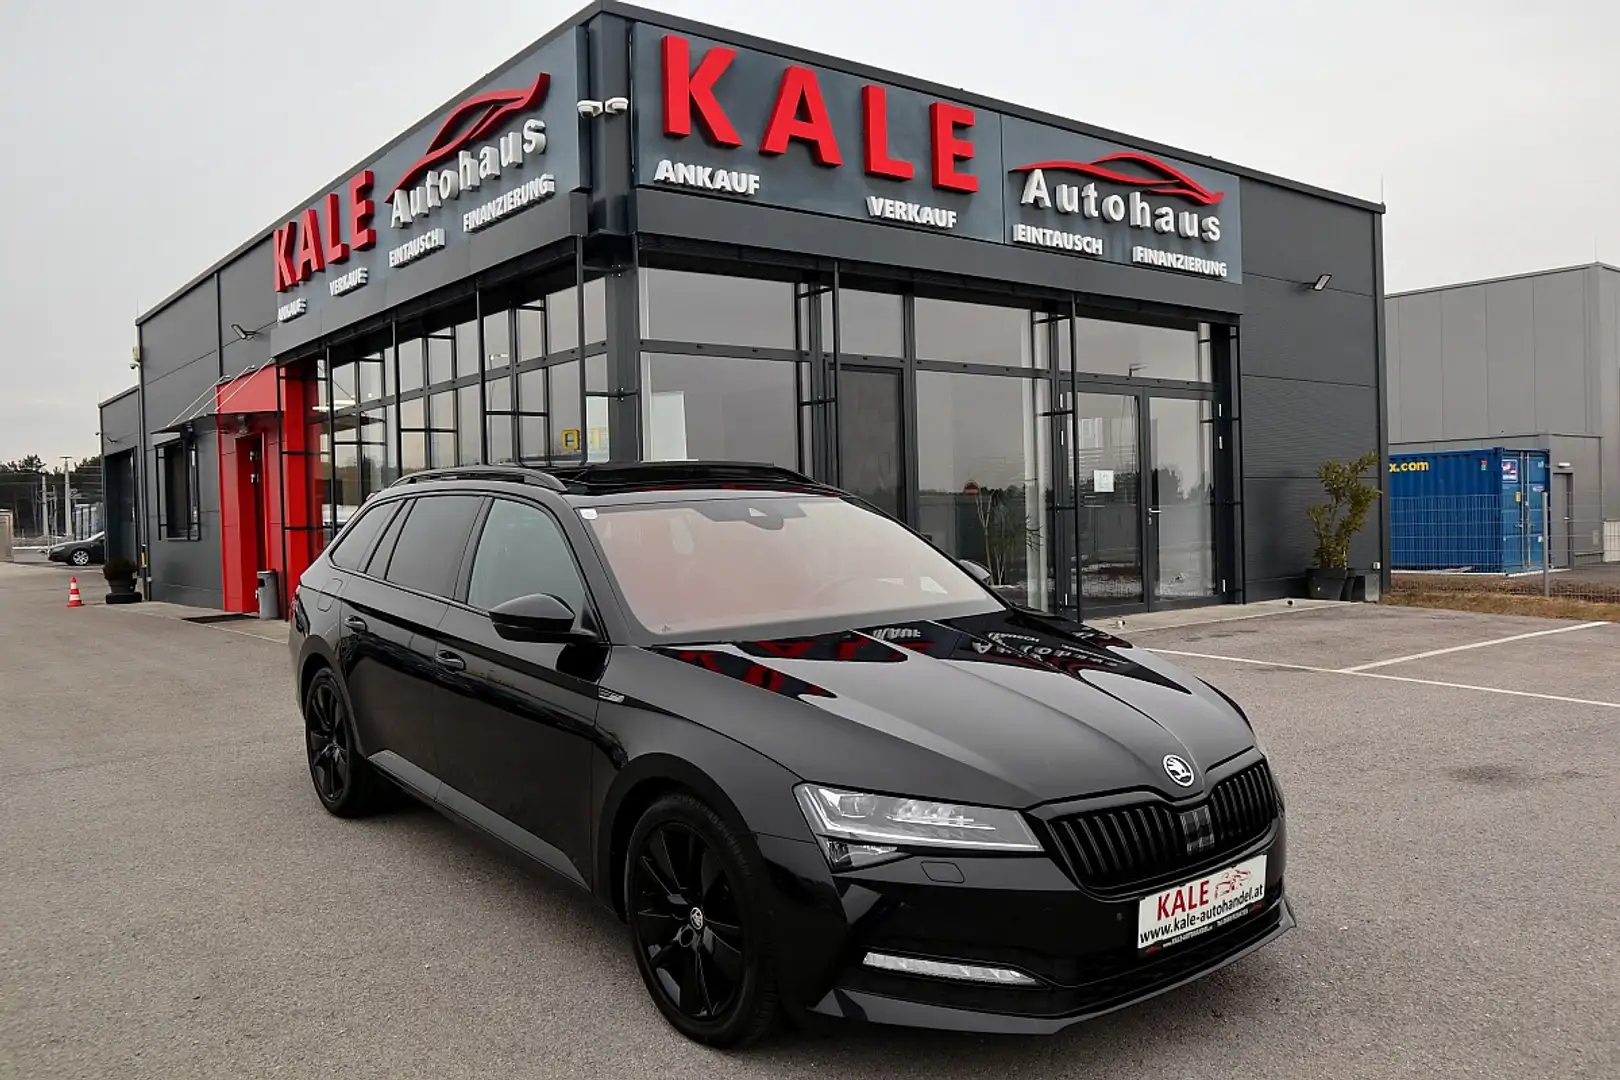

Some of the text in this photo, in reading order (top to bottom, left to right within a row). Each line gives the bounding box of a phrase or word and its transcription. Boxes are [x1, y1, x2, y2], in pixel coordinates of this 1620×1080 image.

[661, 34, 979, 194] KALE
[390, 117, 546, 228] Autohaus
[653, 159, 760, 195] ANKAUF
[463, 173, 555, 232] FINANZIERUNG
[866, 195, 957, 229] VERKAUF
[1020, 168, 1221, 242] Autohaus
[273, 169, 376, 292] KALE
[388, 227, 446, 268] EINTAUSCH
[1012, 223, 1103, 255] EINTAUSCH
[1132, 245, 1228, 277] FINANZIERUNG
[1139, 884, 1263, 944] www.kale-autohandel.at
[1157, 880, 1210, 921] KALE
